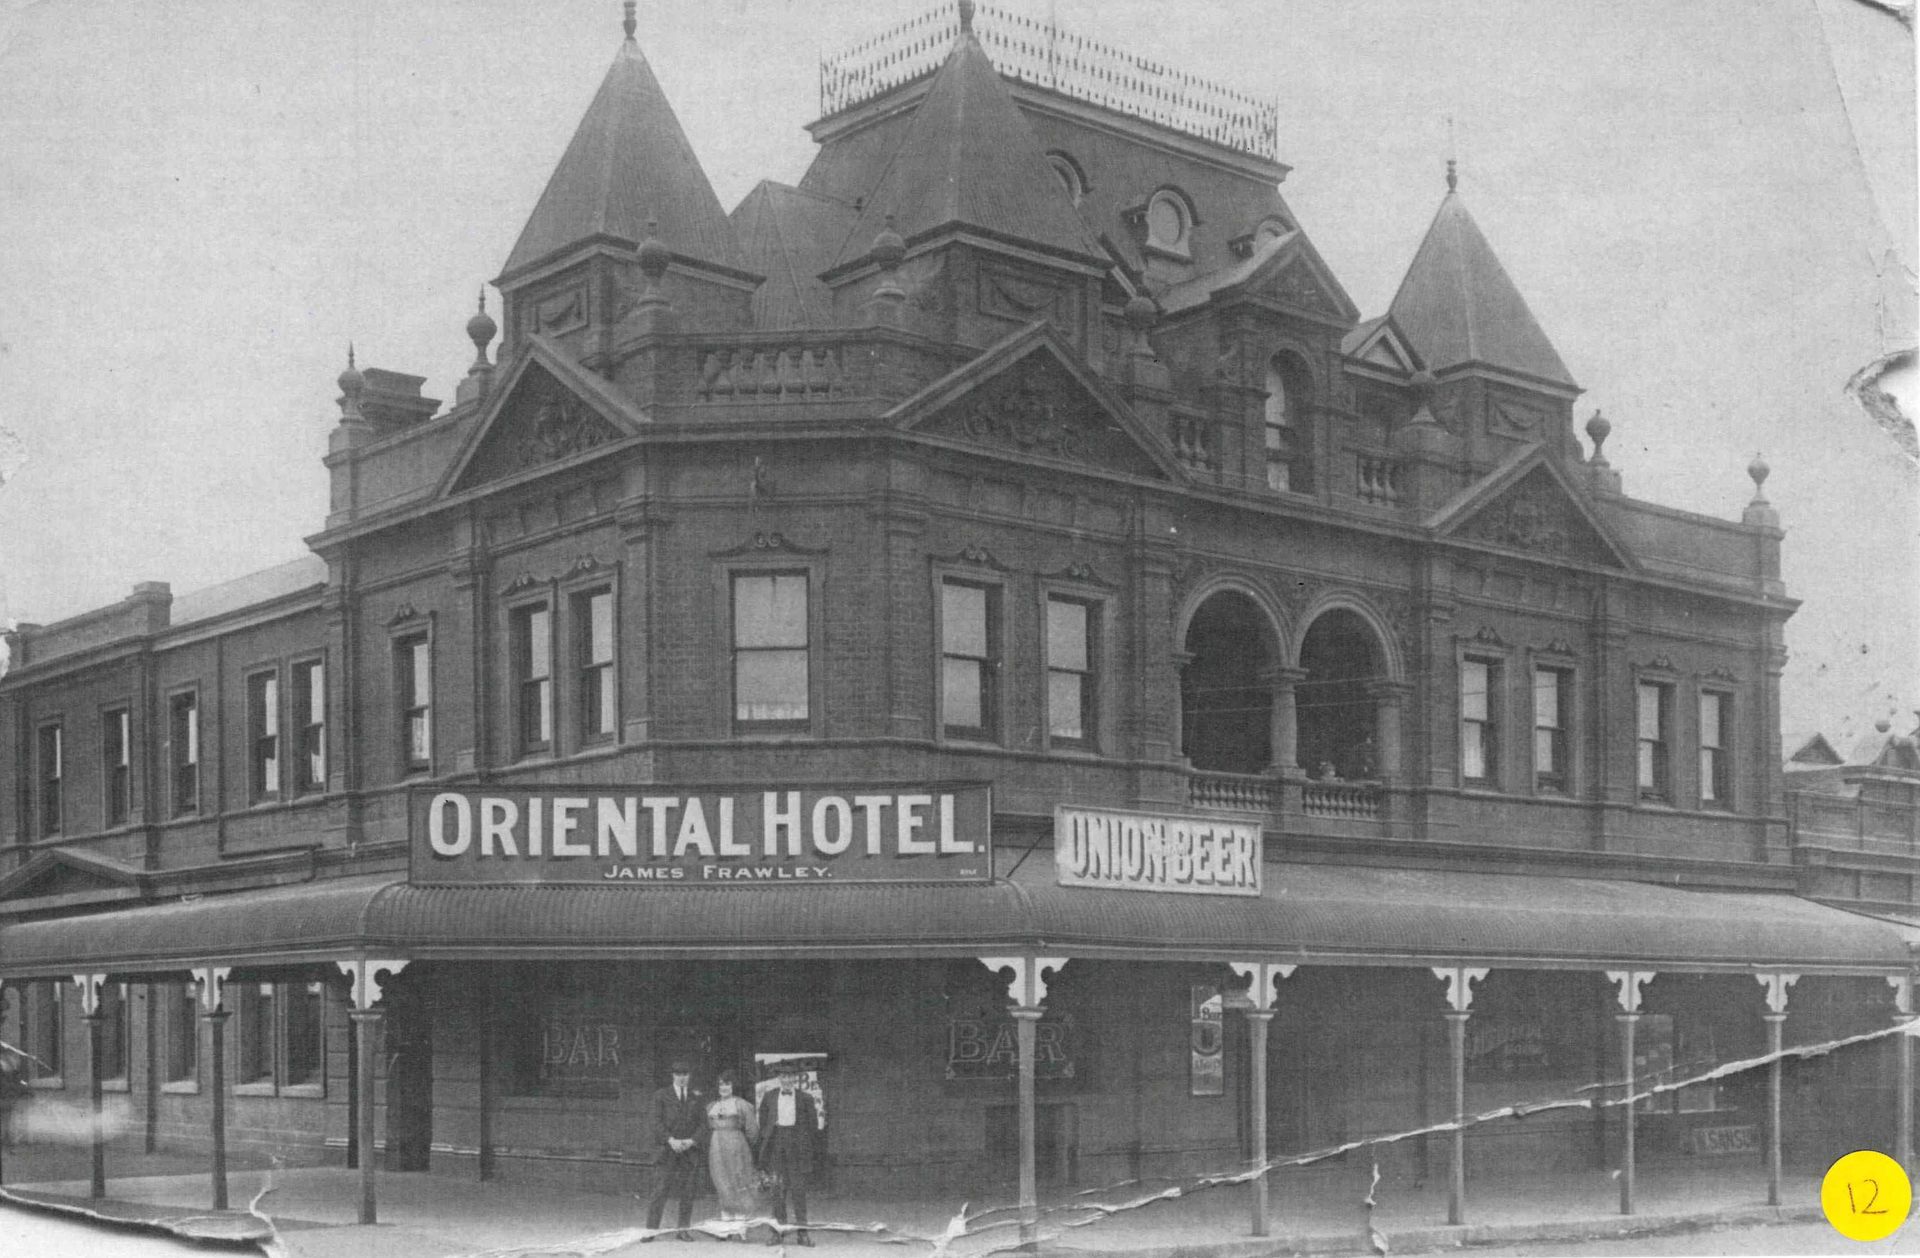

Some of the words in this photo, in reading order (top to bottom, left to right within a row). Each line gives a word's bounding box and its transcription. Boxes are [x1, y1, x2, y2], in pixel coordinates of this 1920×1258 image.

[428, 792, 751, 857] ORIENTAL
[763, 791, 986, 856] HOTEL.
[603, 864, 685, 880] JAMES
[703, 863, 833, 880] FRAWLEY.
[1065, 810, 1167, 883] UNION
[1171, 820, 1258, 889] BEER
[542, 1024, 621, 1068] BAR
[949, 1020, 1067, 1064] BAR
[1847, 1178, 1889, 1215] 12
